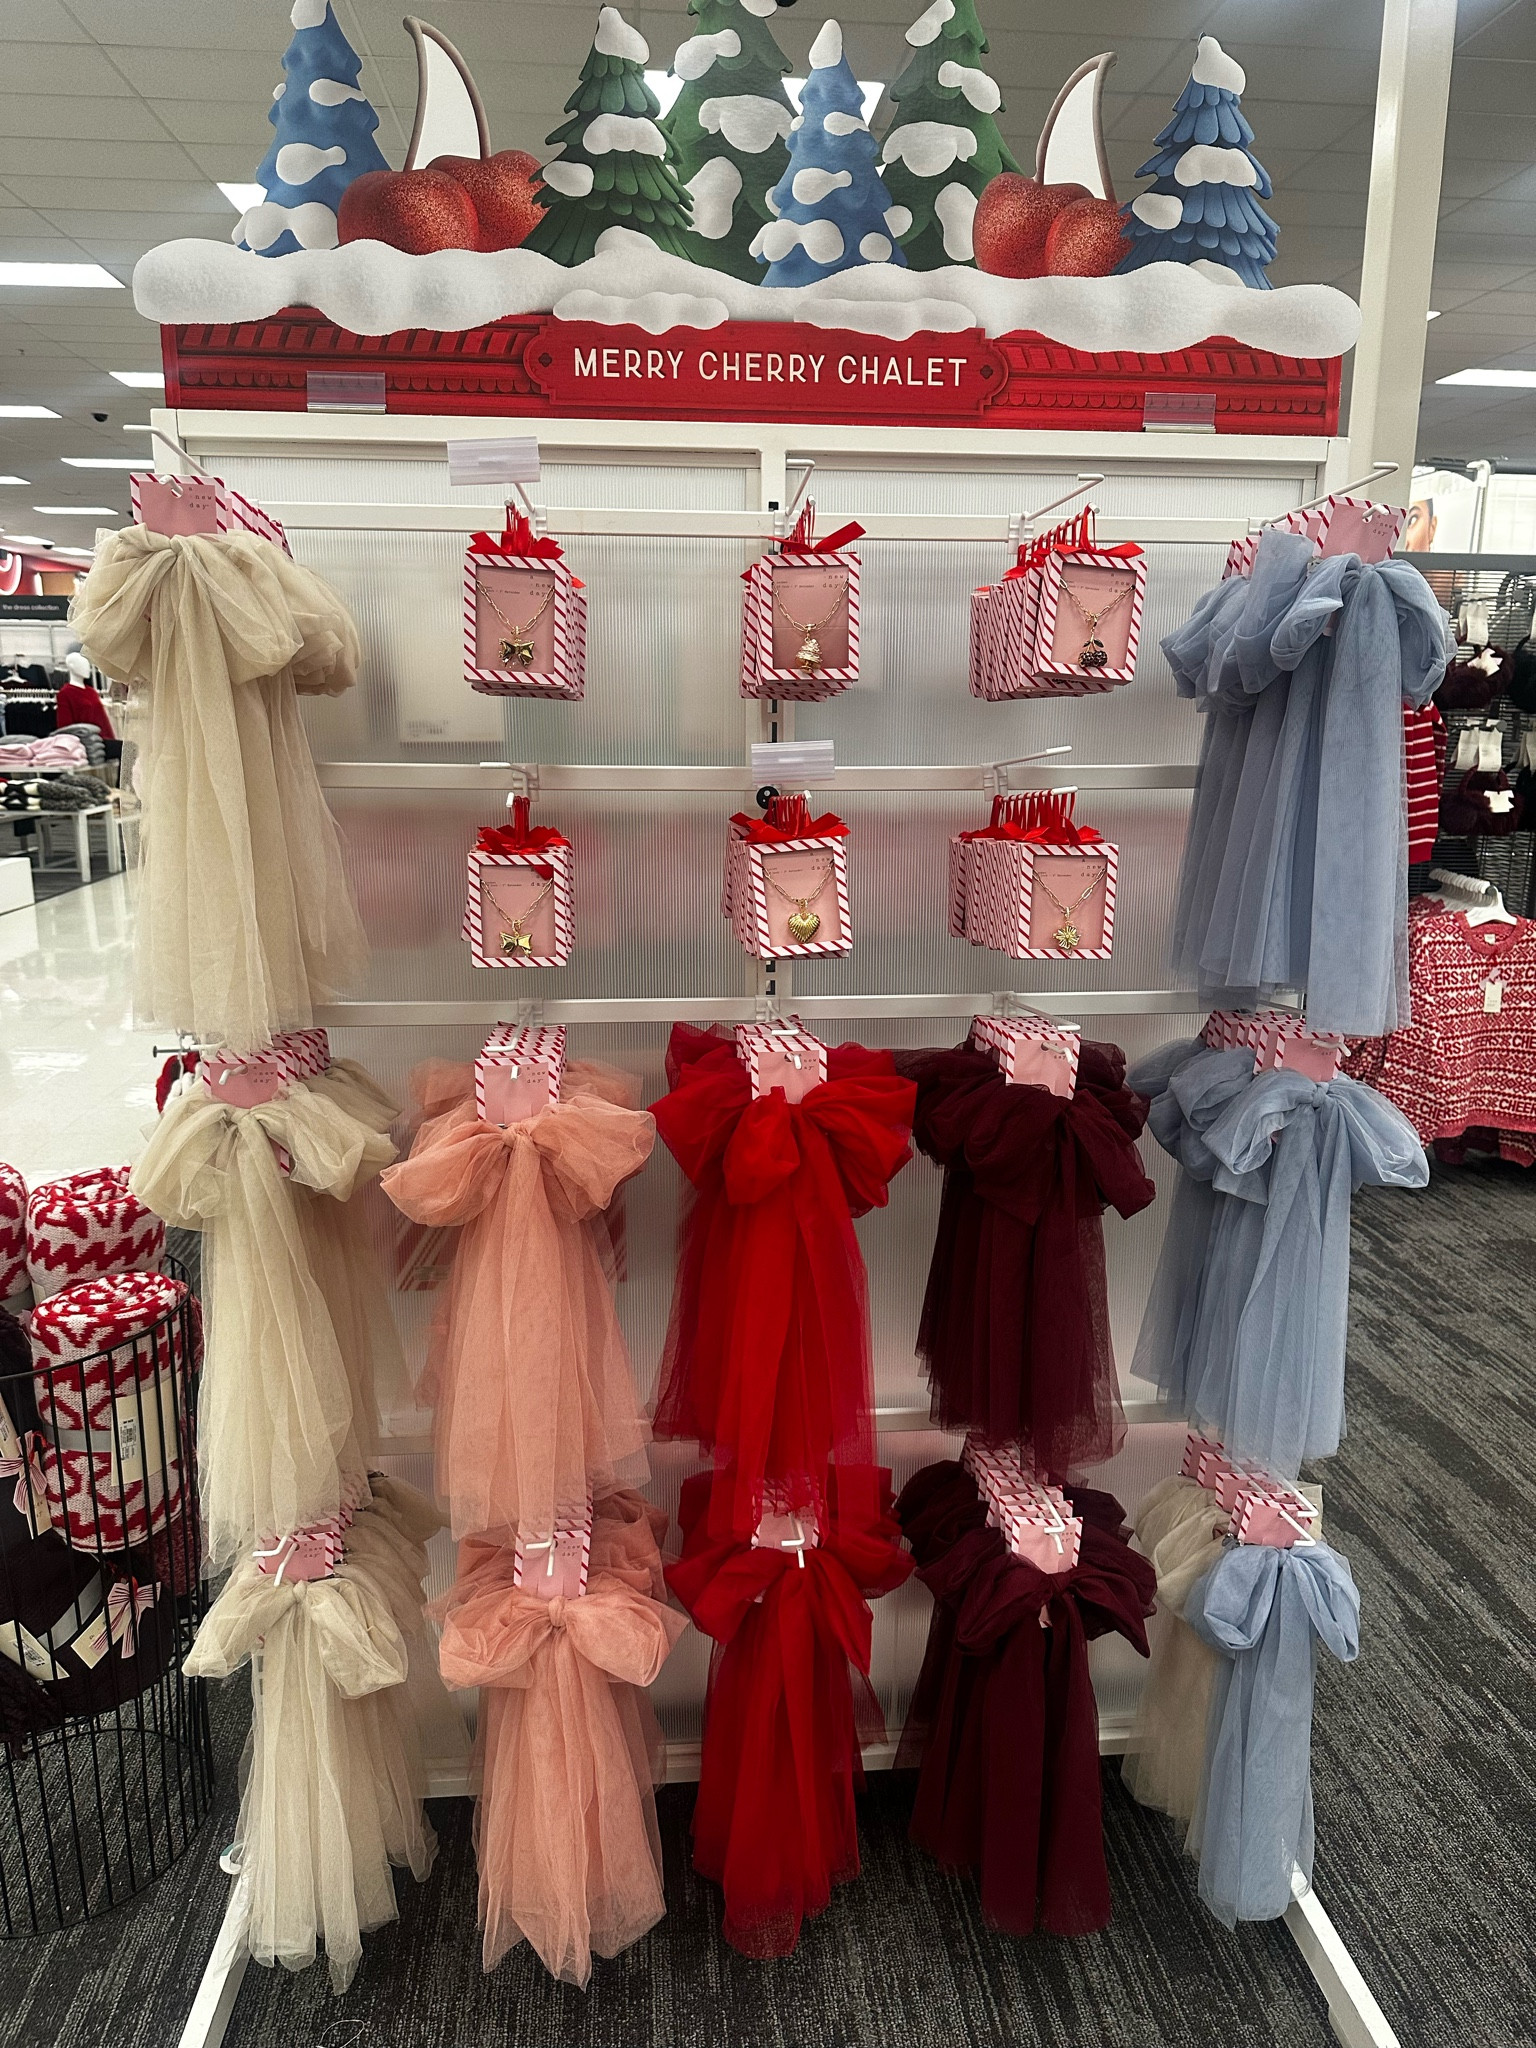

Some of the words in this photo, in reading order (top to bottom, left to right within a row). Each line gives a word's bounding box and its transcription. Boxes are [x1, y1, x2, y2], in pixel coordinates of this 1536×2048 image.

[574, 347, 684, 380] MERRY
[698, 350, 825, 383] CHERRY
[837, 355, 968, 387] CHALET
[1512, 1034, 1536, 1049] CHE
[1499, 1098, 1536, 1114] CHEER
